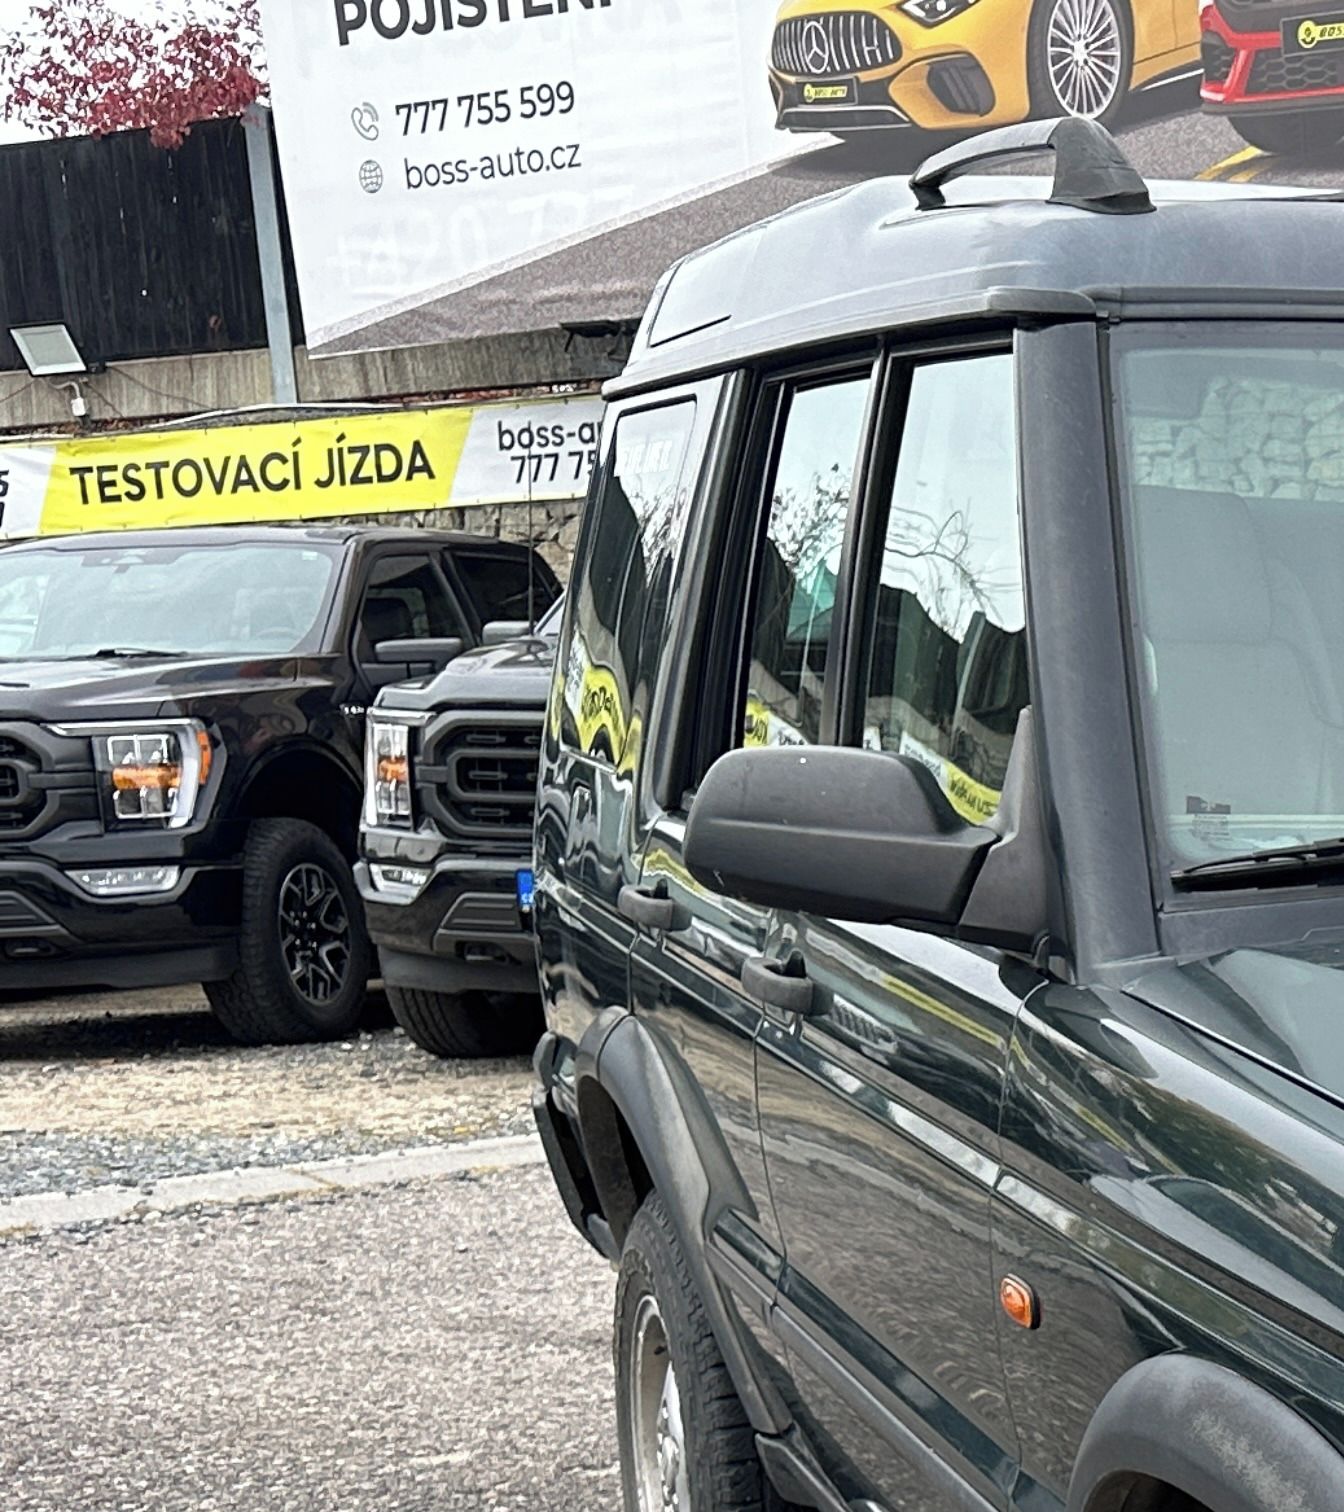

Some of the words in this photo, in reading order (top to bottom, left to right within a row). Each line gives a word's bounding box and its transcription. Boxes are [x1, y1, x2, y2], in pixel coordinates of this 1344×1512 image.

[395, 98, 449, 137] 777
[457, 89, 511, 128] 755
[519, 80, 575, 120] 599
[403, 143, 582, 190] boss-auto.cz
[69, 436, 303, 506] TESTOVACÍ
[313, 432, 437, 489] JÍZDA
[509, 452, 560, 485] 777
